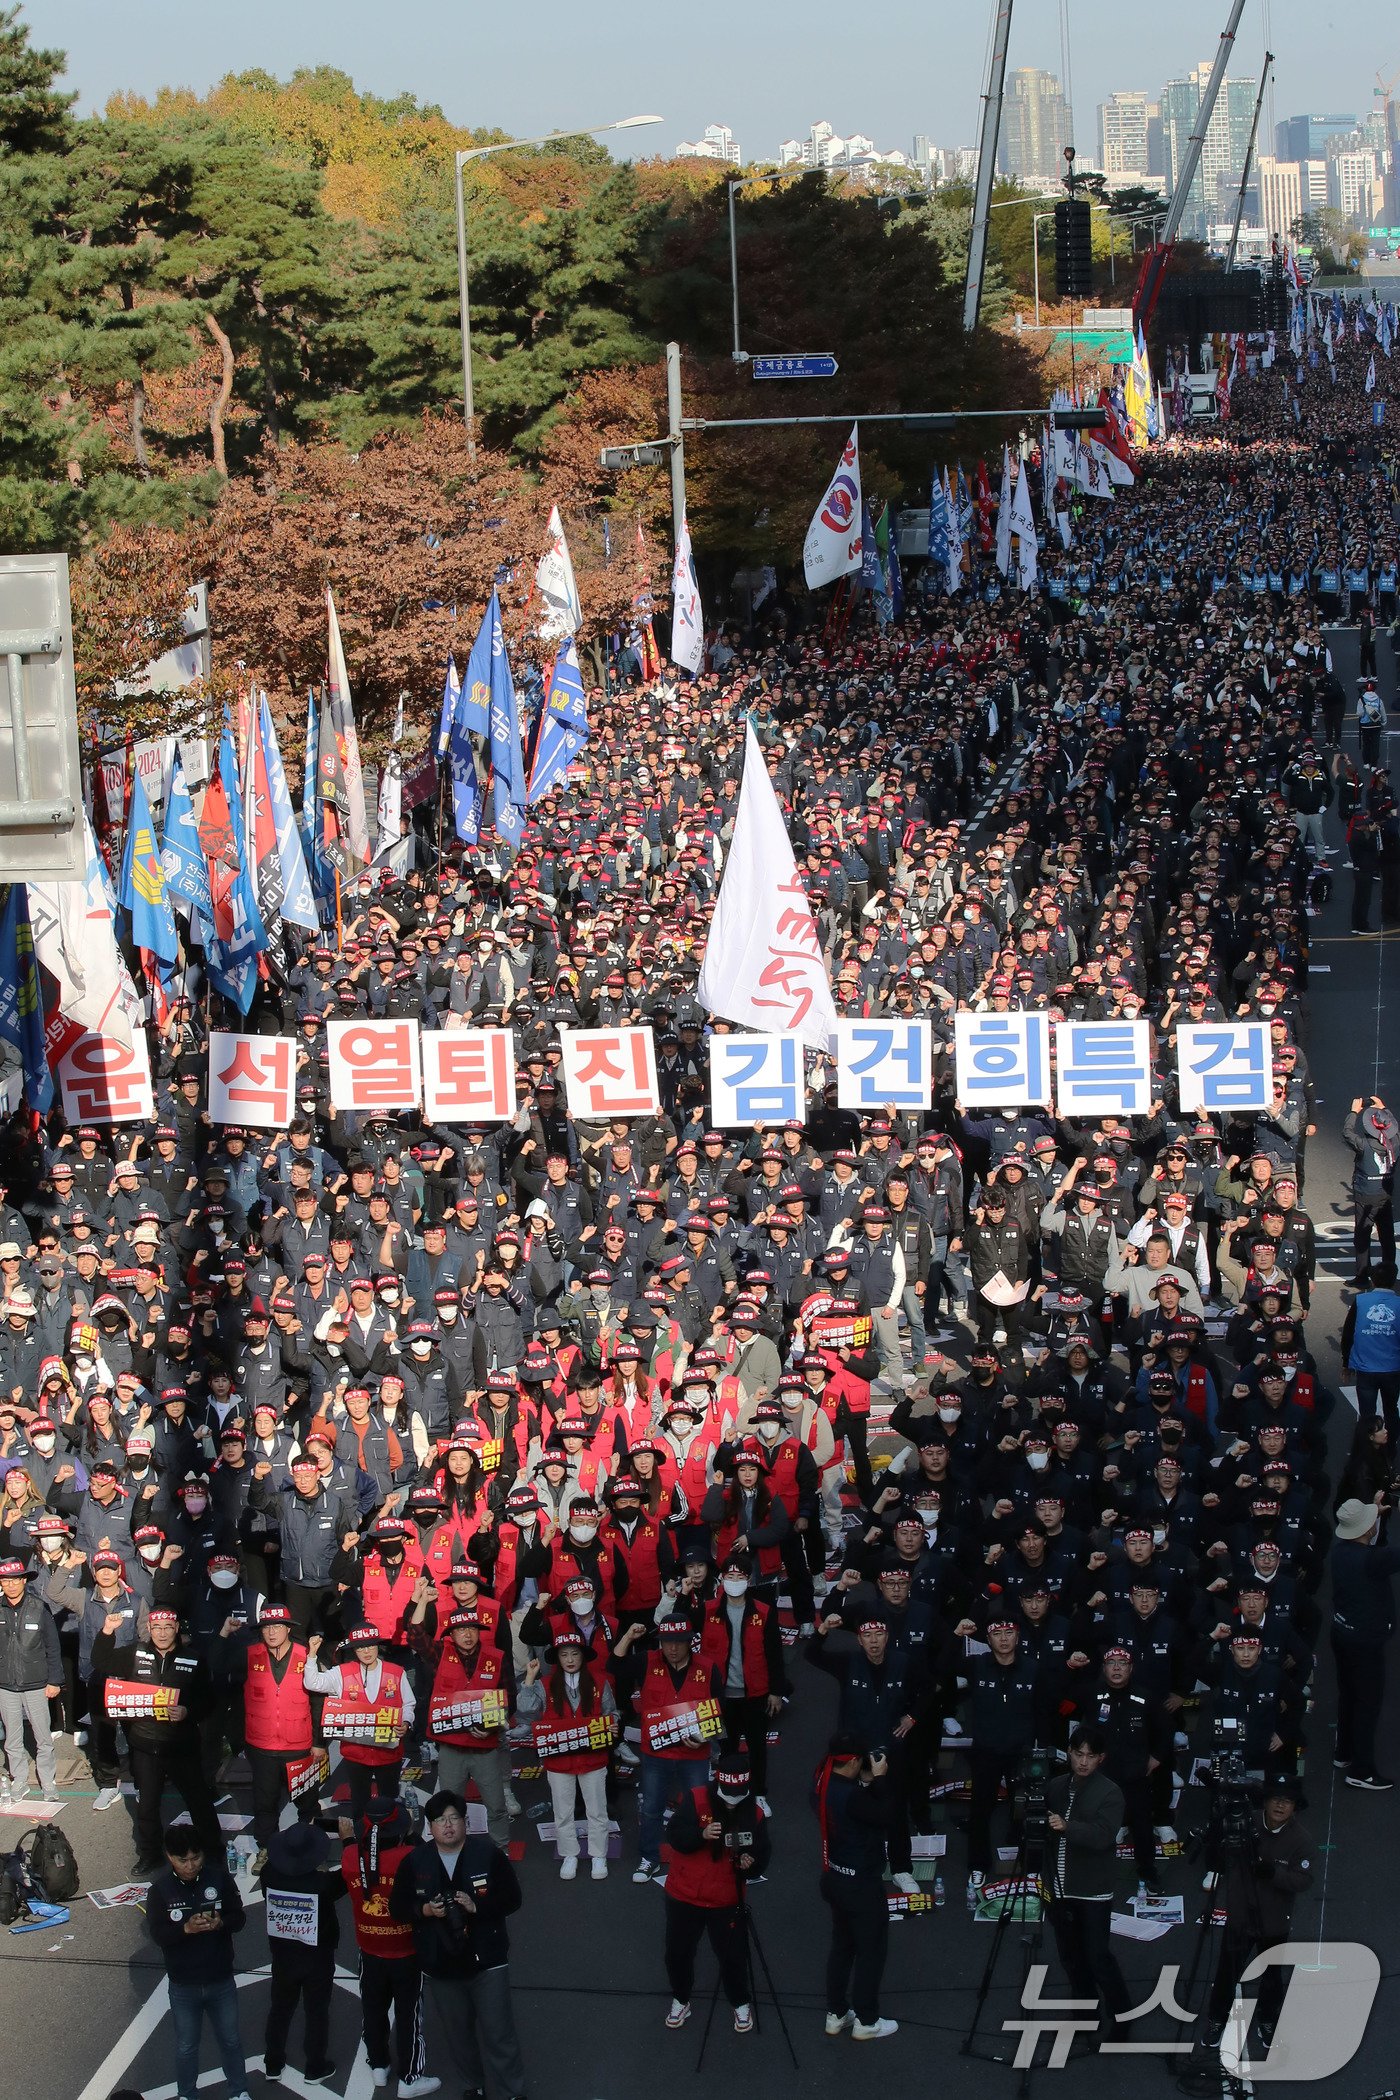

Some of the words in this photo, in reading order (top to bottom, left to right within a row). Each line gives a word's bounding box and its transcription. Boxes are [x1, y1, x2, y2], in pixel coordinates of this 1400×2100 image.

[756, 360, 805, 371] 국제금융로
[138, 748, 161, 777] 2024
[432, 1699, 482, 1720] 윤석열정권
[324, 1713, 376, 1728] 윤석열정권
[432, 1713, 482, 1733] 반노동정책
[649, 1711, 697, 1736] 윤석열정권
[322, 1726, 374, 1742] 반노동정책
[536, 1726, 588, 1747] 윤석열정권
[651, 1723, 700, 1750] 반노동정책
[537, 1737, 590, 1758] 반노동정책
